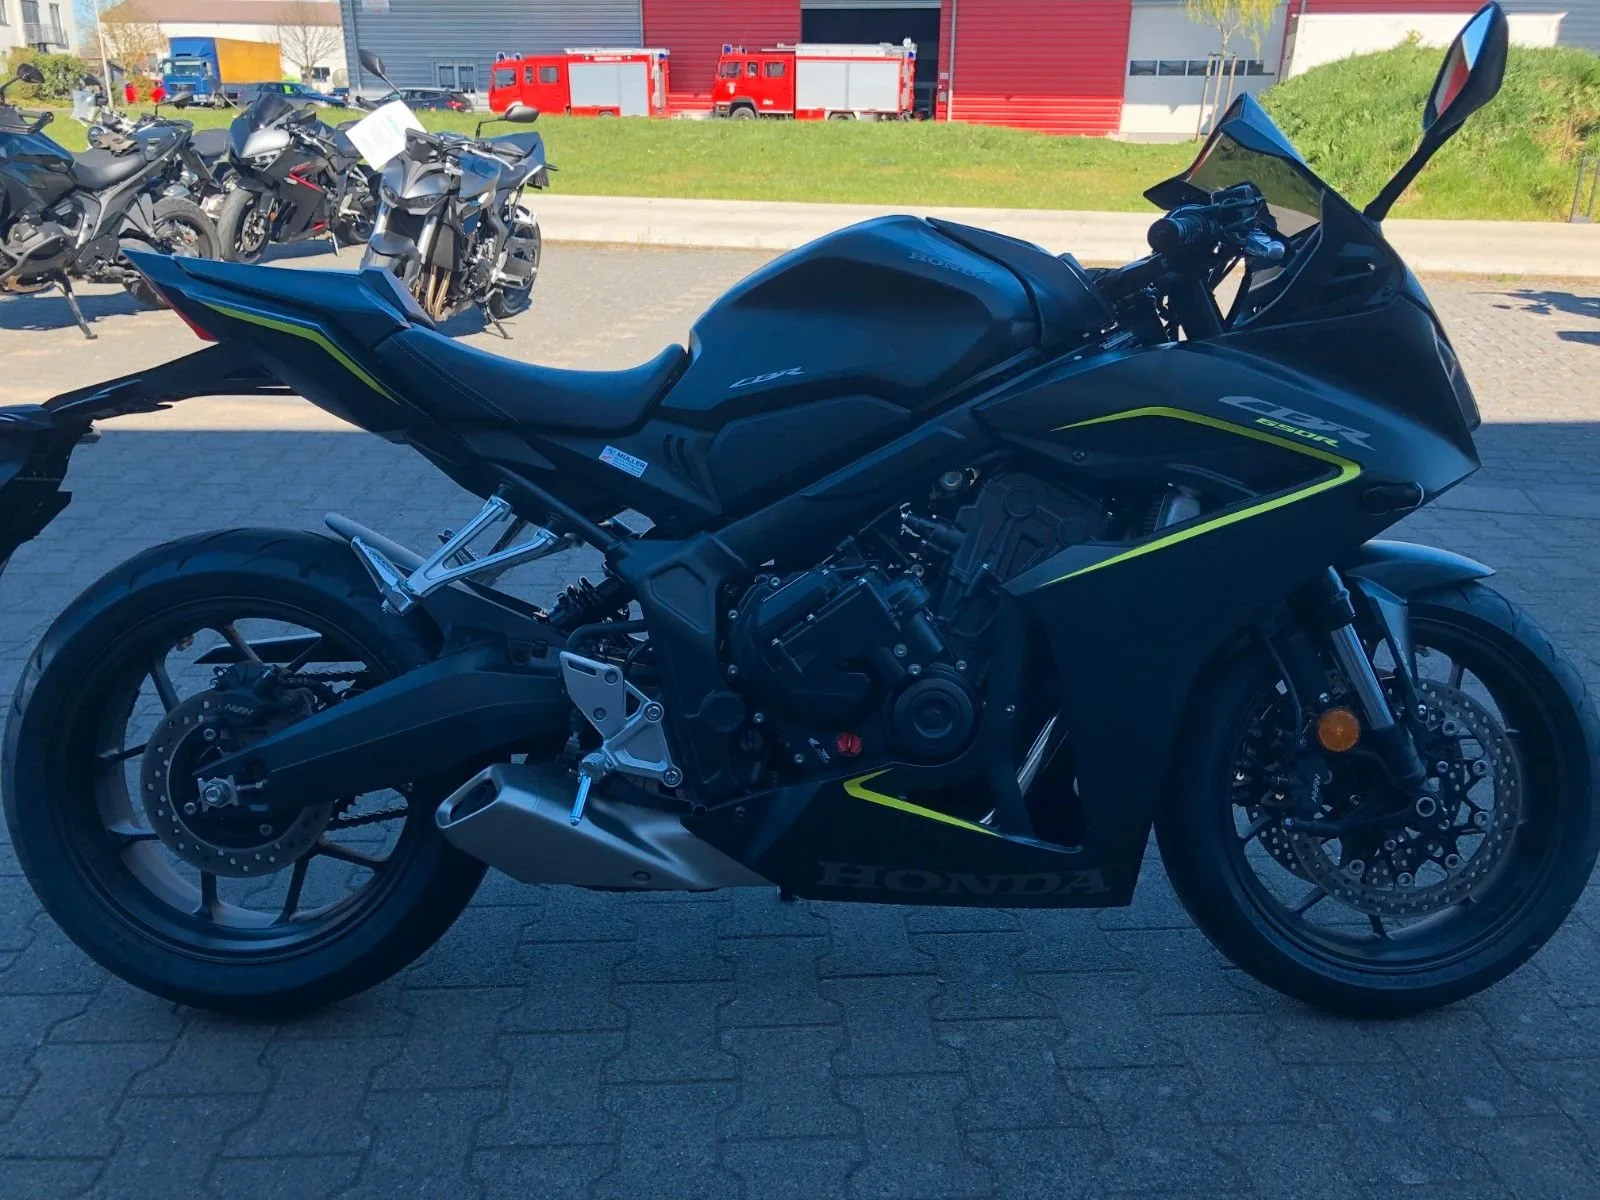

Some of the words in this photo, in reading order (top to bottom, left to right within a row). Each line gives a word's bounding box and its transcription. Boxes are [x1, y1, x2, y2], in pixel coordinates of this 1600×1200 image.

[729, 366, 806, 390] CBR
[1218, 395, 1376, 451] CBR
[1255, 417, 1339, 448] 650R
[815, 860, 1111, 896] HONDA
